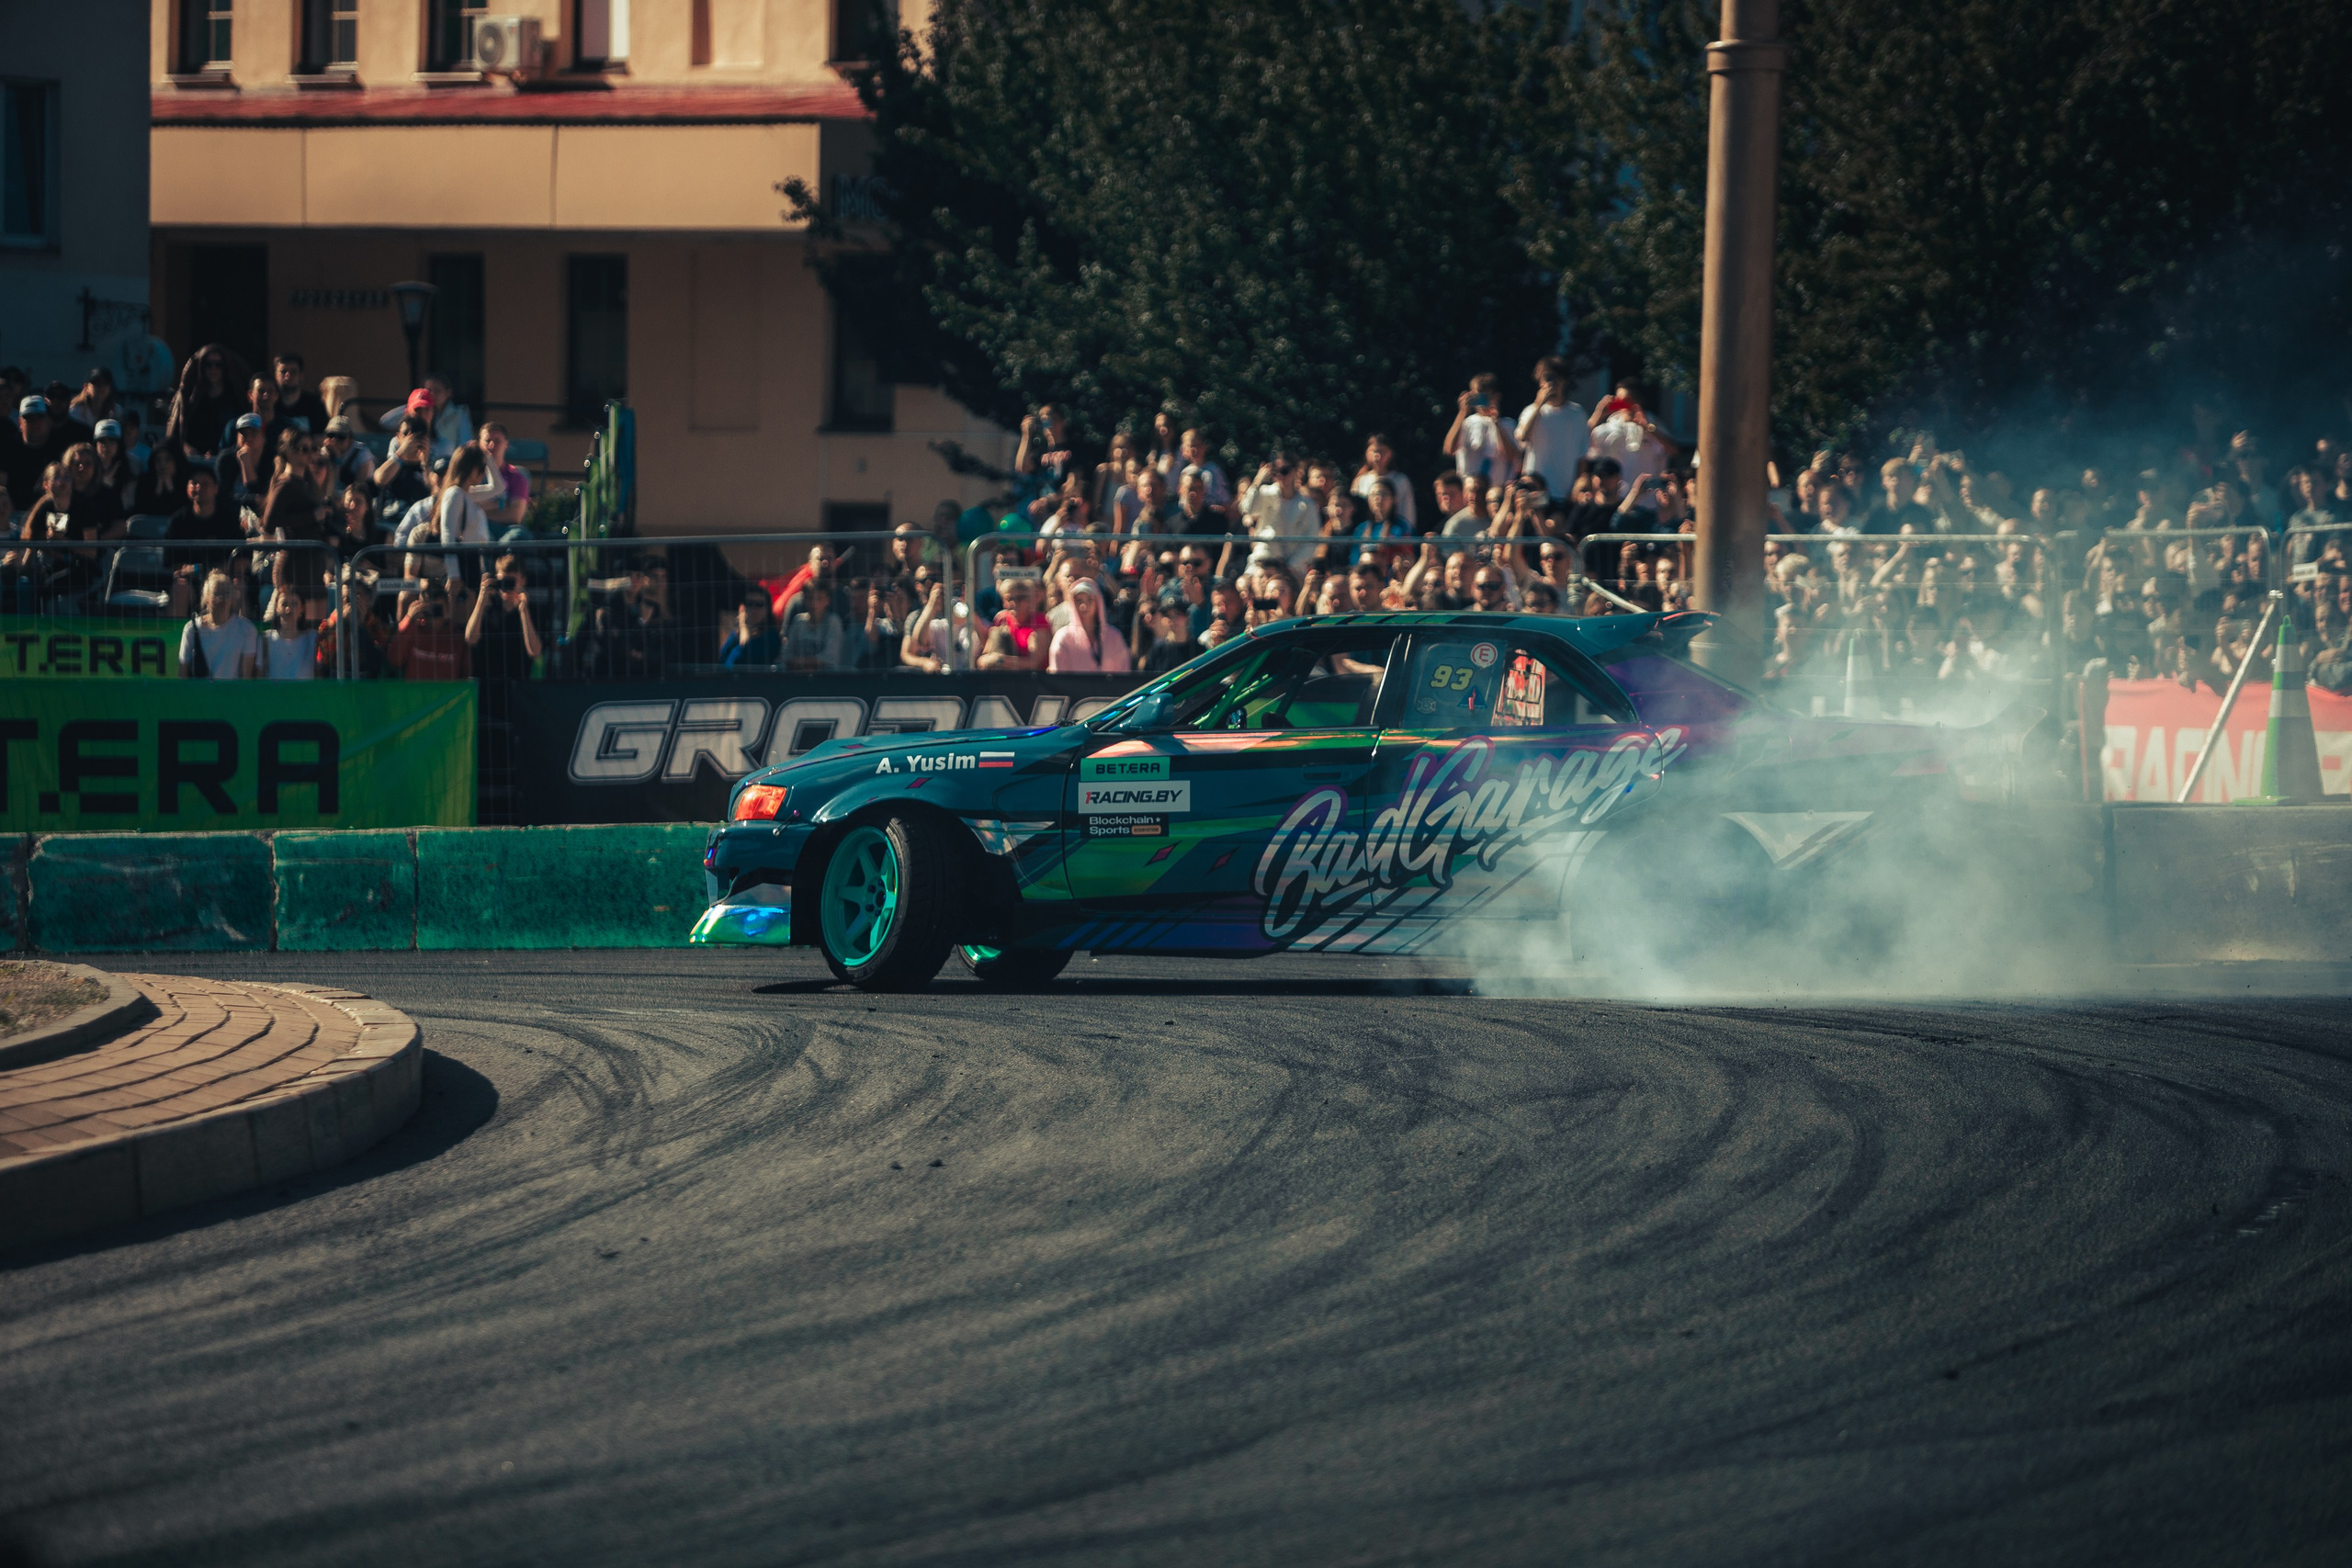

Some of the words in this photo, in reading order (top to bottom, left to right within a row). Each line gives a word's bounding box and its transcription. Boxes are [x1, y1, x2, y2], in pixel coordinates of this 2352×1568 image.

[1478, 649, 1490, 661] E
[1430, 664, 1474, 691] 93
[876, 757, 899, 774] A.
[906, 752, 976, 773] Yusim
[1089, 816, 1154, 825] Blockchain
[1089, 826, 1130, 836] Sports
